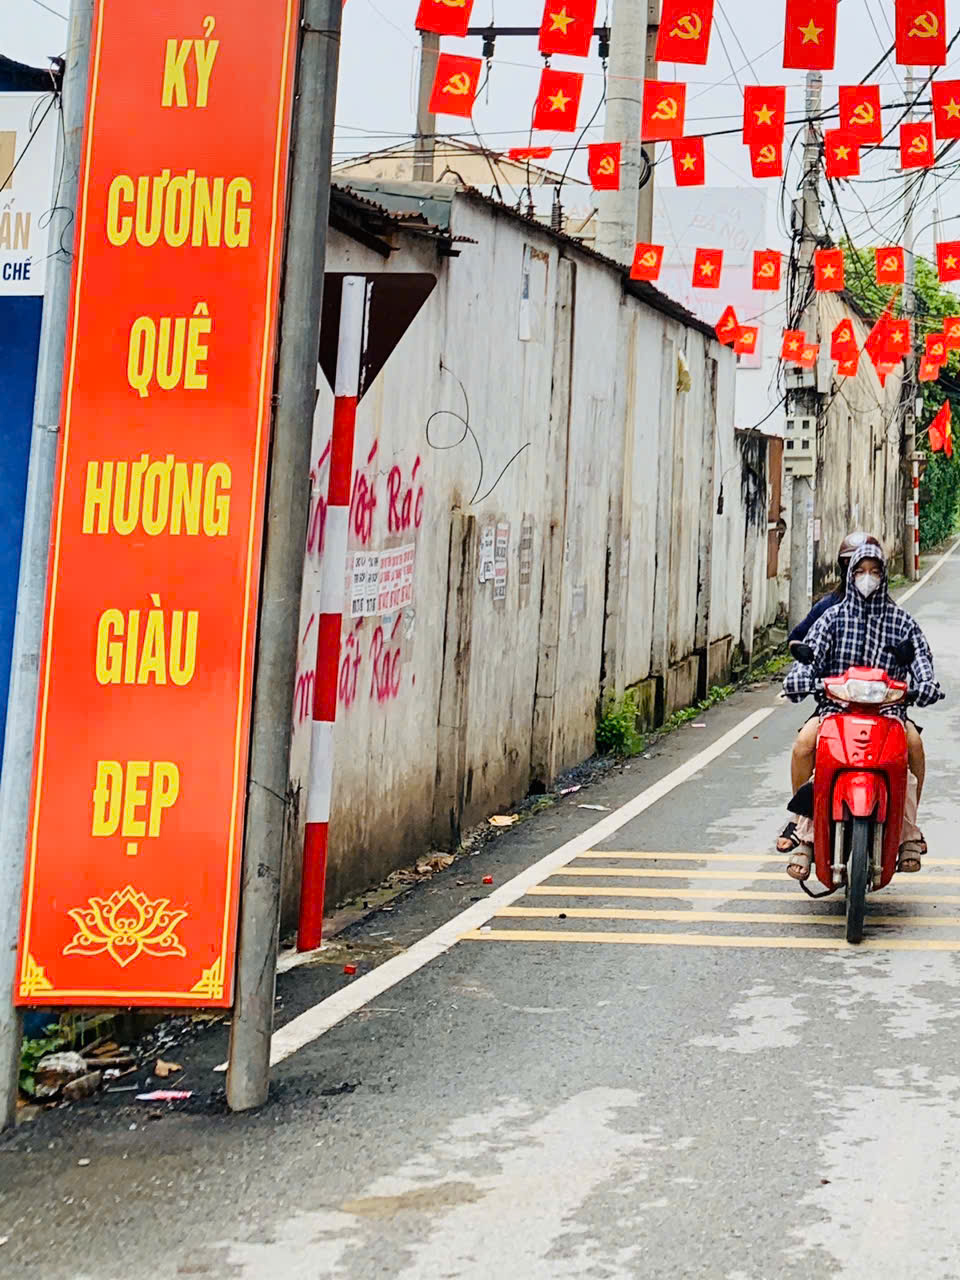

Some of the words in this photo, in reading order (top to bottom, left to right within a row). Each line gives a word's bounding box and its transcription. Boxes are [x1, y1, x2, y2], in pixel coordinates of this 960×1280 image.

[161, 15, 219, 107] KỶ
[106, 169, 252, 248] CƯƠNG
[2, 256, 33, 281] CHẾ
[127, 303, 211, 398] QUÊ
[82, 454, 232, 537] HƯƠNG
[386, 454, 424, 534] Rác
[95, 593, 199, 686] GIÀU
[340, 616, 362, 710] ất
[91, 759, 180, 856] ĐẸP
